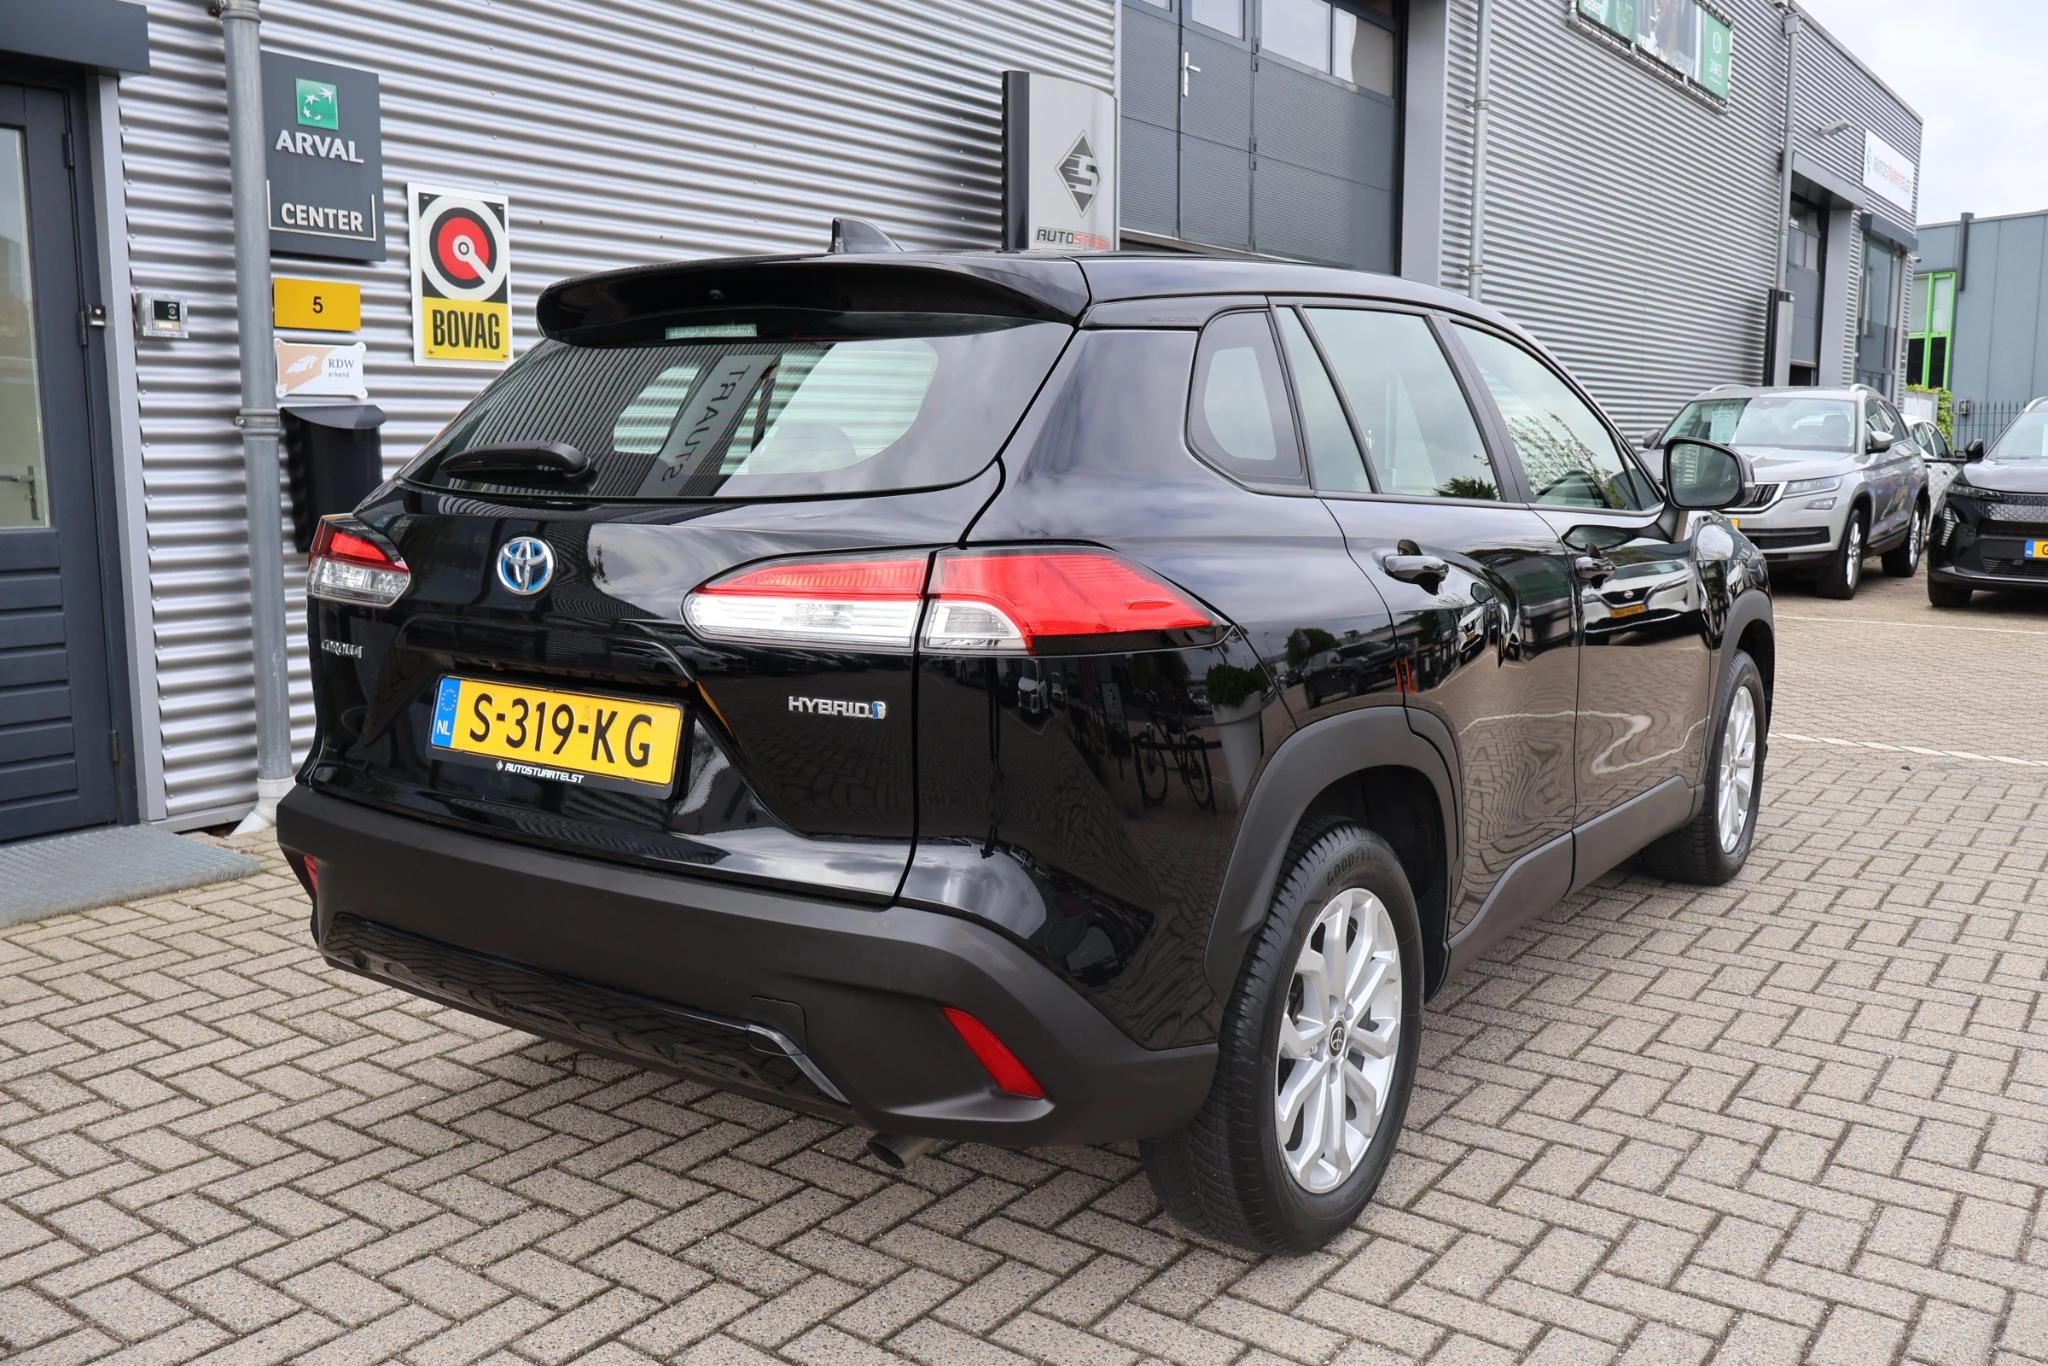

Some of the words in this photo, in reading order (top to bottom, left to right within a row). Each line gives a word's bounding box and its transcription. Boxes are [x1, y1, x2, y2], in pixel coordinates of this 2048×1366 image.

[275, 129, 364, 164] ARVAL
[281, 202, 364, 232] CENTER
[312, 296, 324, 314] 5
[432, 309, 500, 350] BOVAG
[328, 359, 355, 369] RDW
[788, 696, 870, 718] HYBRID
[436, 719, 450, 736] NL
[469, 692, 653, 768] S-319-KG
